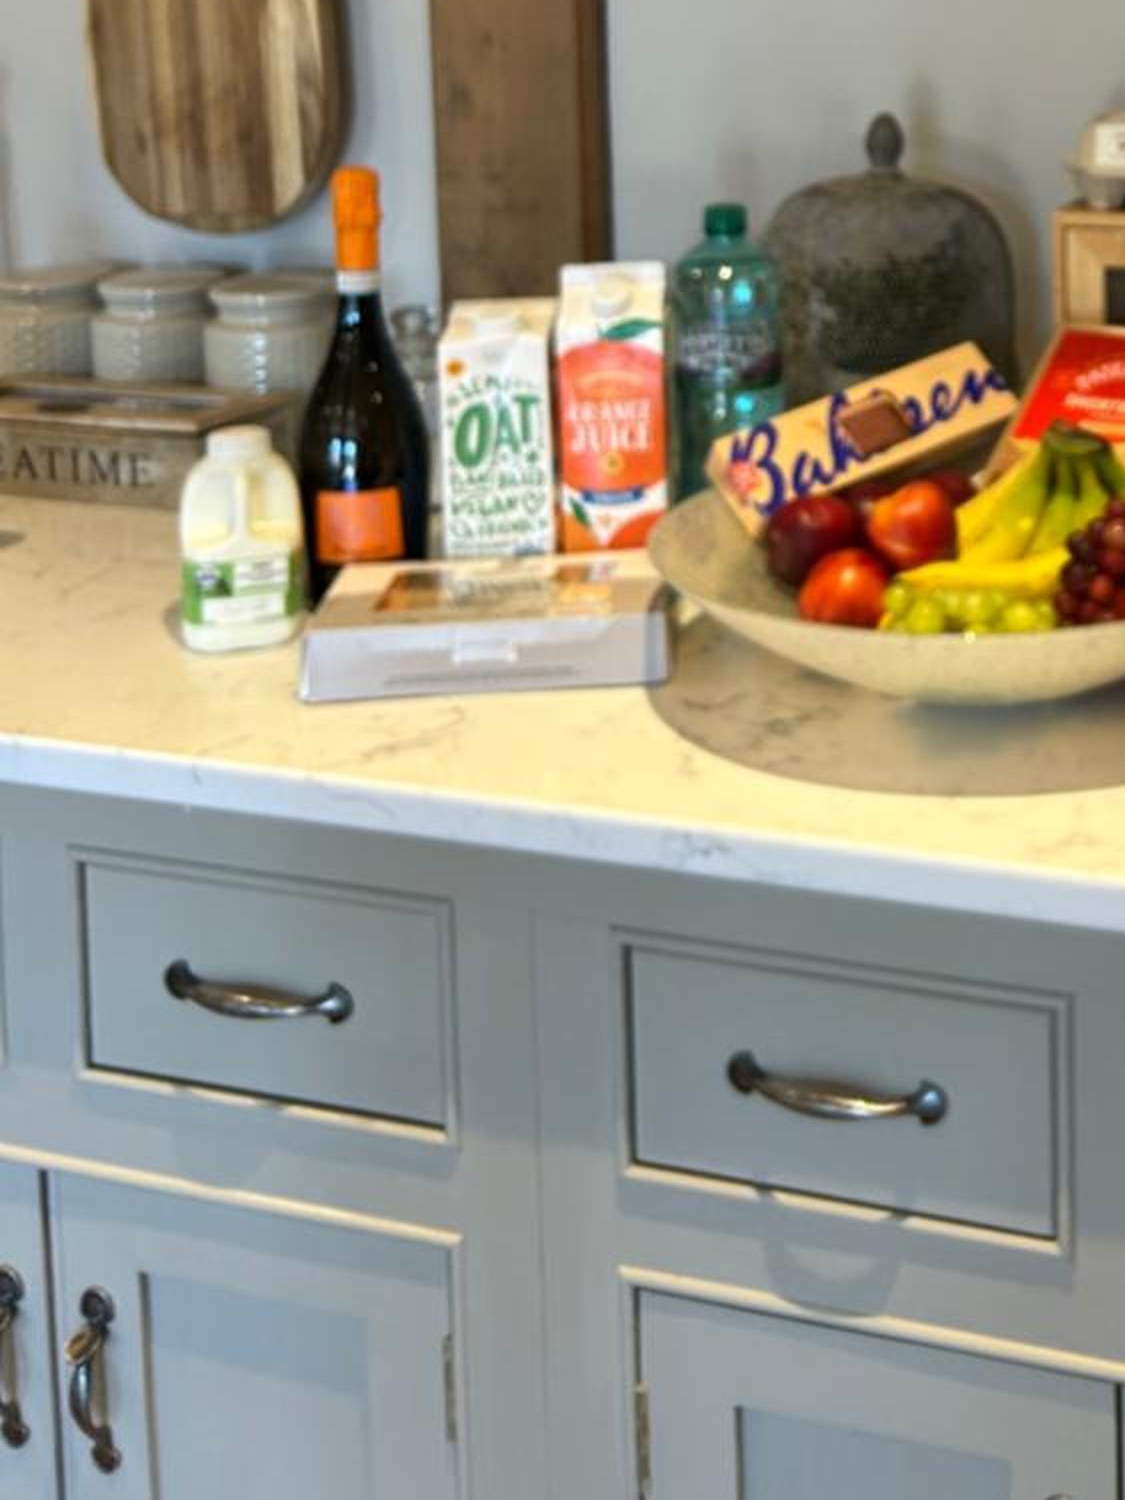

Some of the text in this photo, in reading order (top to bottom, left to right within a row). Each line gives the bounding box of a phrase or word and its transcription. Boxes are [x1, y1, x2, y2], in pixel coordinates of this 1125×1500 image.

[568, 399, 650, 421] ORANGE
[454, 393, 541, 469] OAT
[570, 420, 650, 453] JUICE
